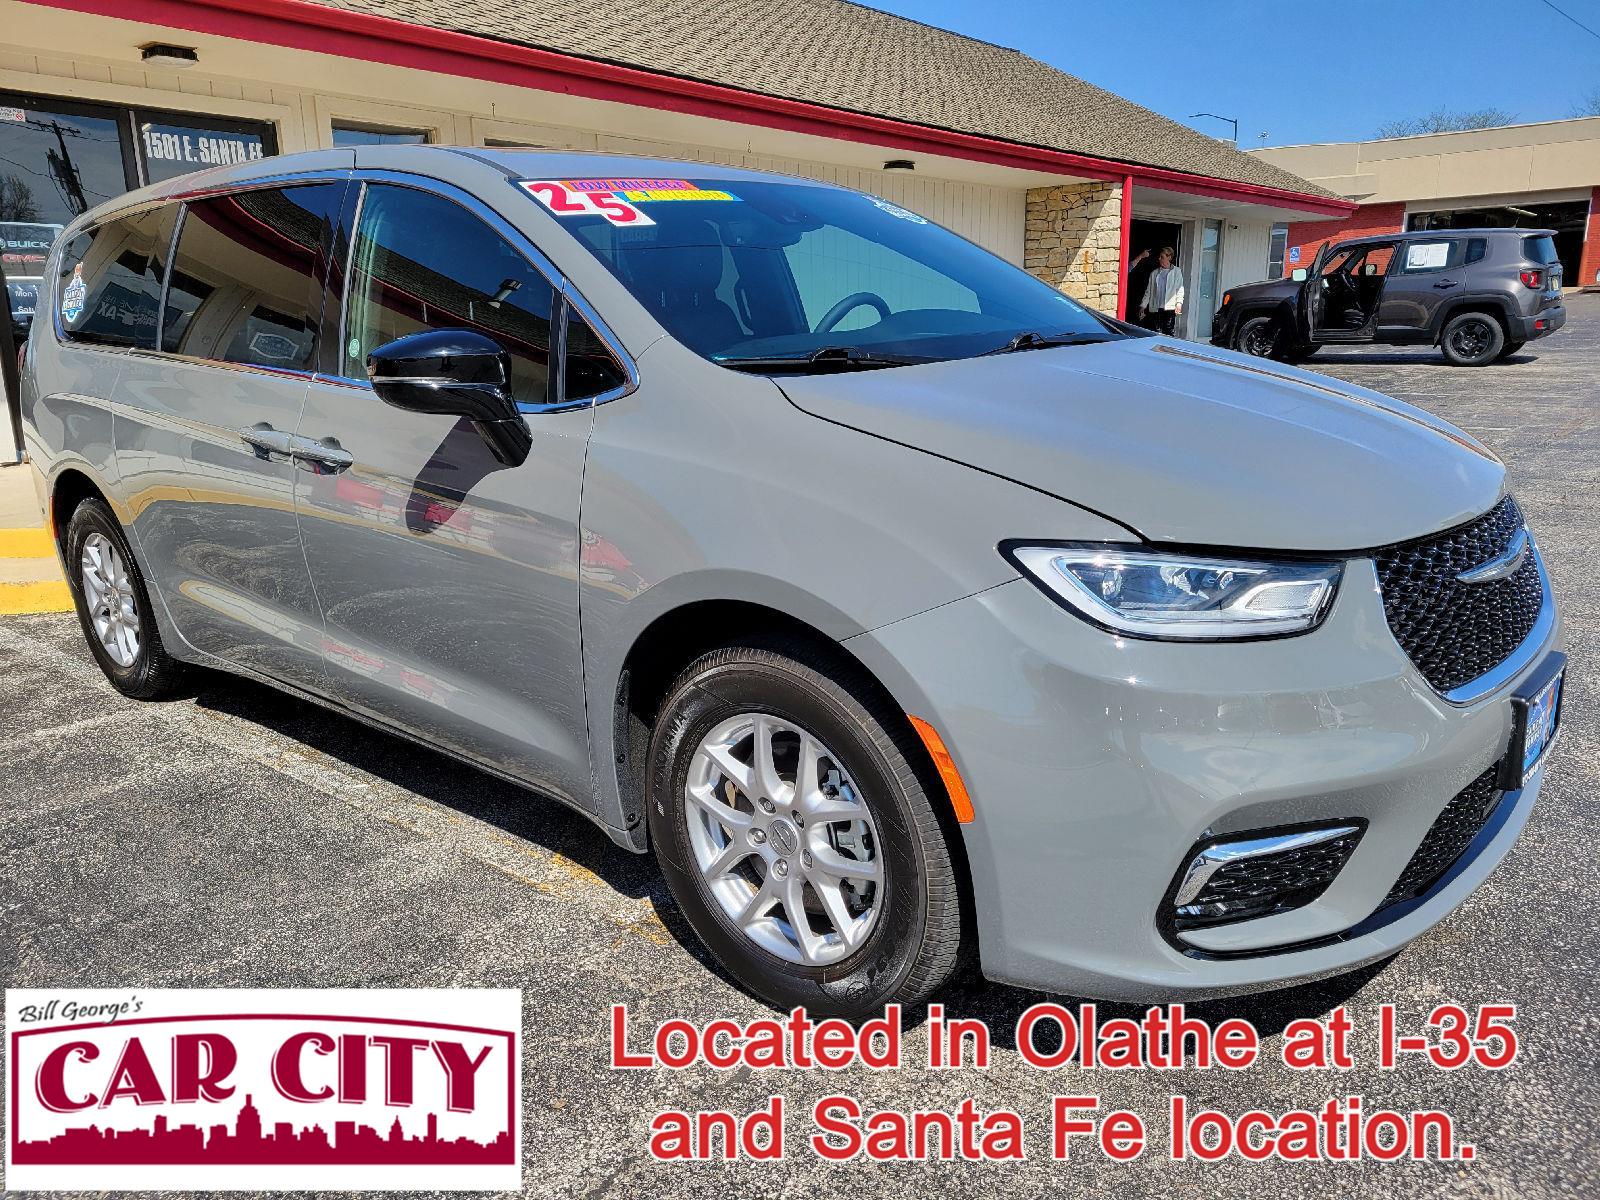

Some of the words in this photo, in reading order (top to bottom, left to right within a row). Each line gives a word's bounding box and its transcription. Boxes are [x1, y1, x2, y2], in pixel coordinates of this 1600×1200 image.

[143, 131, 182, 161] 1501
[183, 135, 199, 163] E.
[199, 136, 248, 165] SANTA
[568, 181, 610, 191] LOW
[611, 180, 686, 191] MILEAGE
[7, 240, 50, 249] BUICK
[2, 253, 46, 263] GMC
